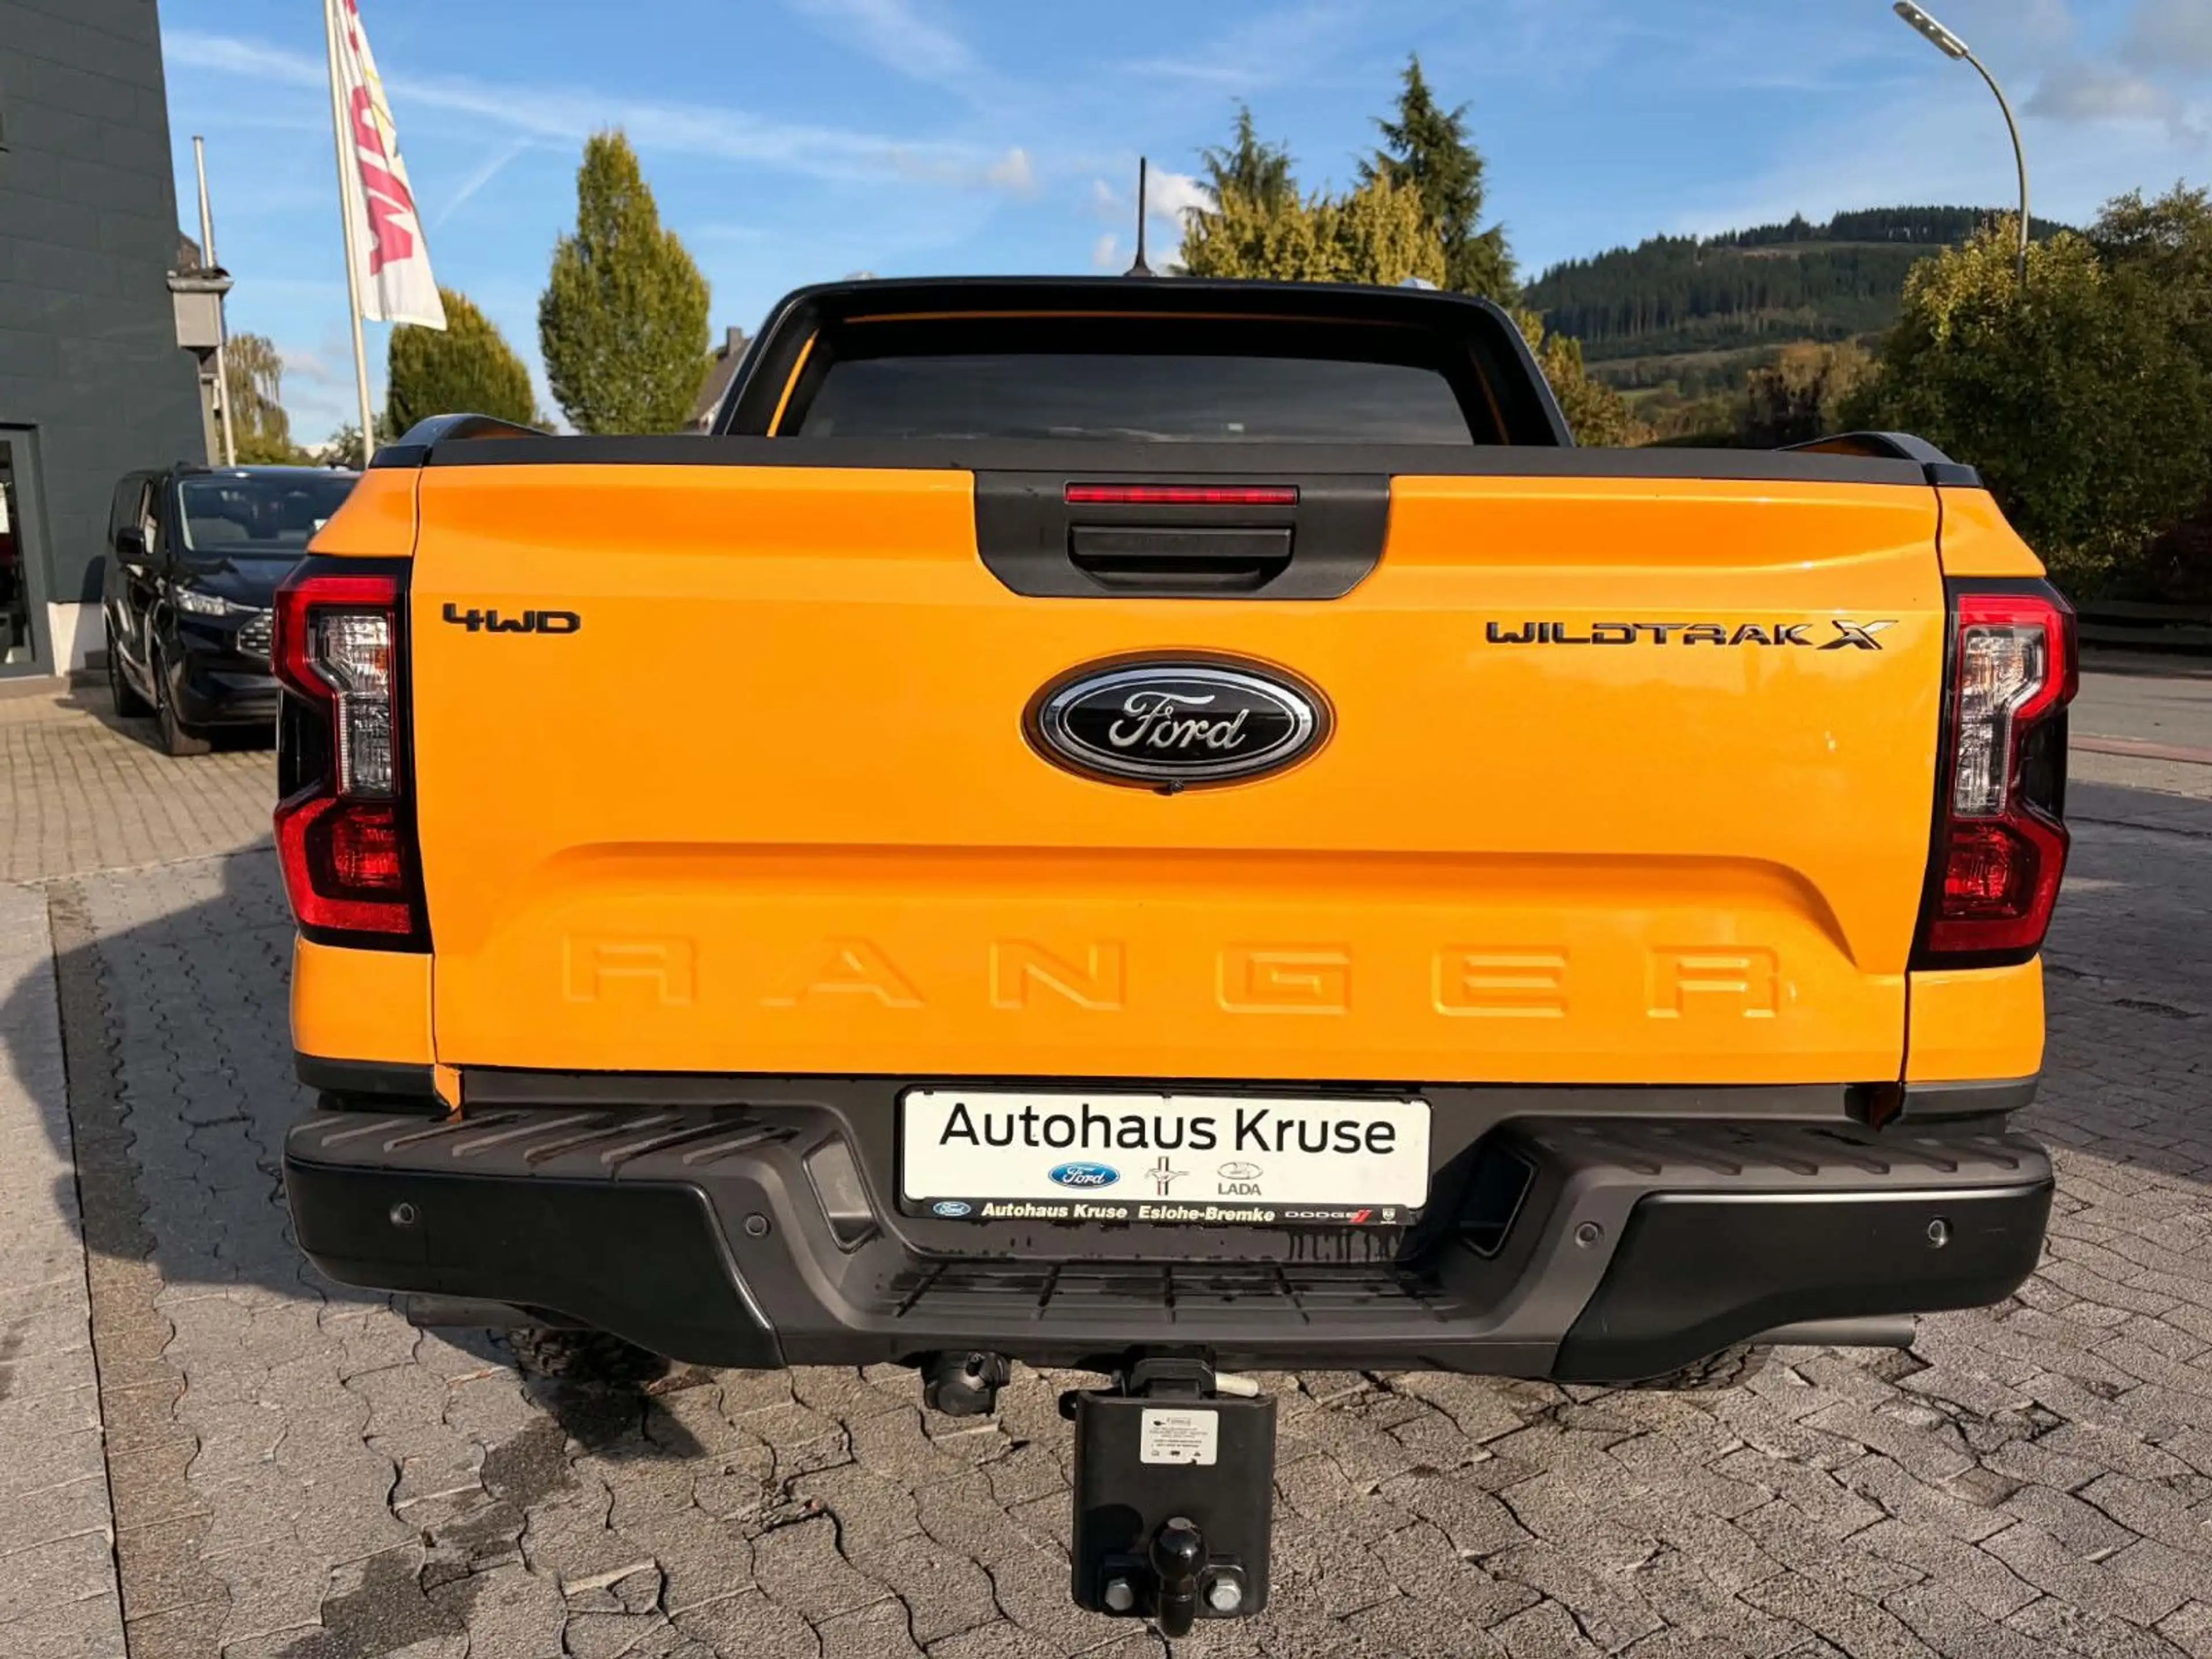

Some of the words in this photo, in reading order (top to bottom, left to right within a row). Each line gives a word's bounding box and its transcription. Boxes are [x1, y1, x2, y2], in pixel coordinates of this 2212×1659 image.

[442, 603, 581, 633] 4WD
[1486, 621, 1813, 646] WILDTRAK
[1817, 620, 1899, 650] X
[1108, 691, 1250, 749] Ford
[561, 932, 1780, 1018] RANGER
[939, 1103, 1217, 1150] Autohaus
[1236, 1108, 1396, 1155] Kruse
[1062, 1165, 1105, 1184] Ford
[1217, 1183, 1262, 1196] LADA
[981, 1202, 1068, 1218] Autohaus
[1073, 1204, 1128, 1218] Kruse
[1138, 1205, 1275, 1221] Eslohe-Bremke
[1285, 1211, 1358, 1219] DODGE
